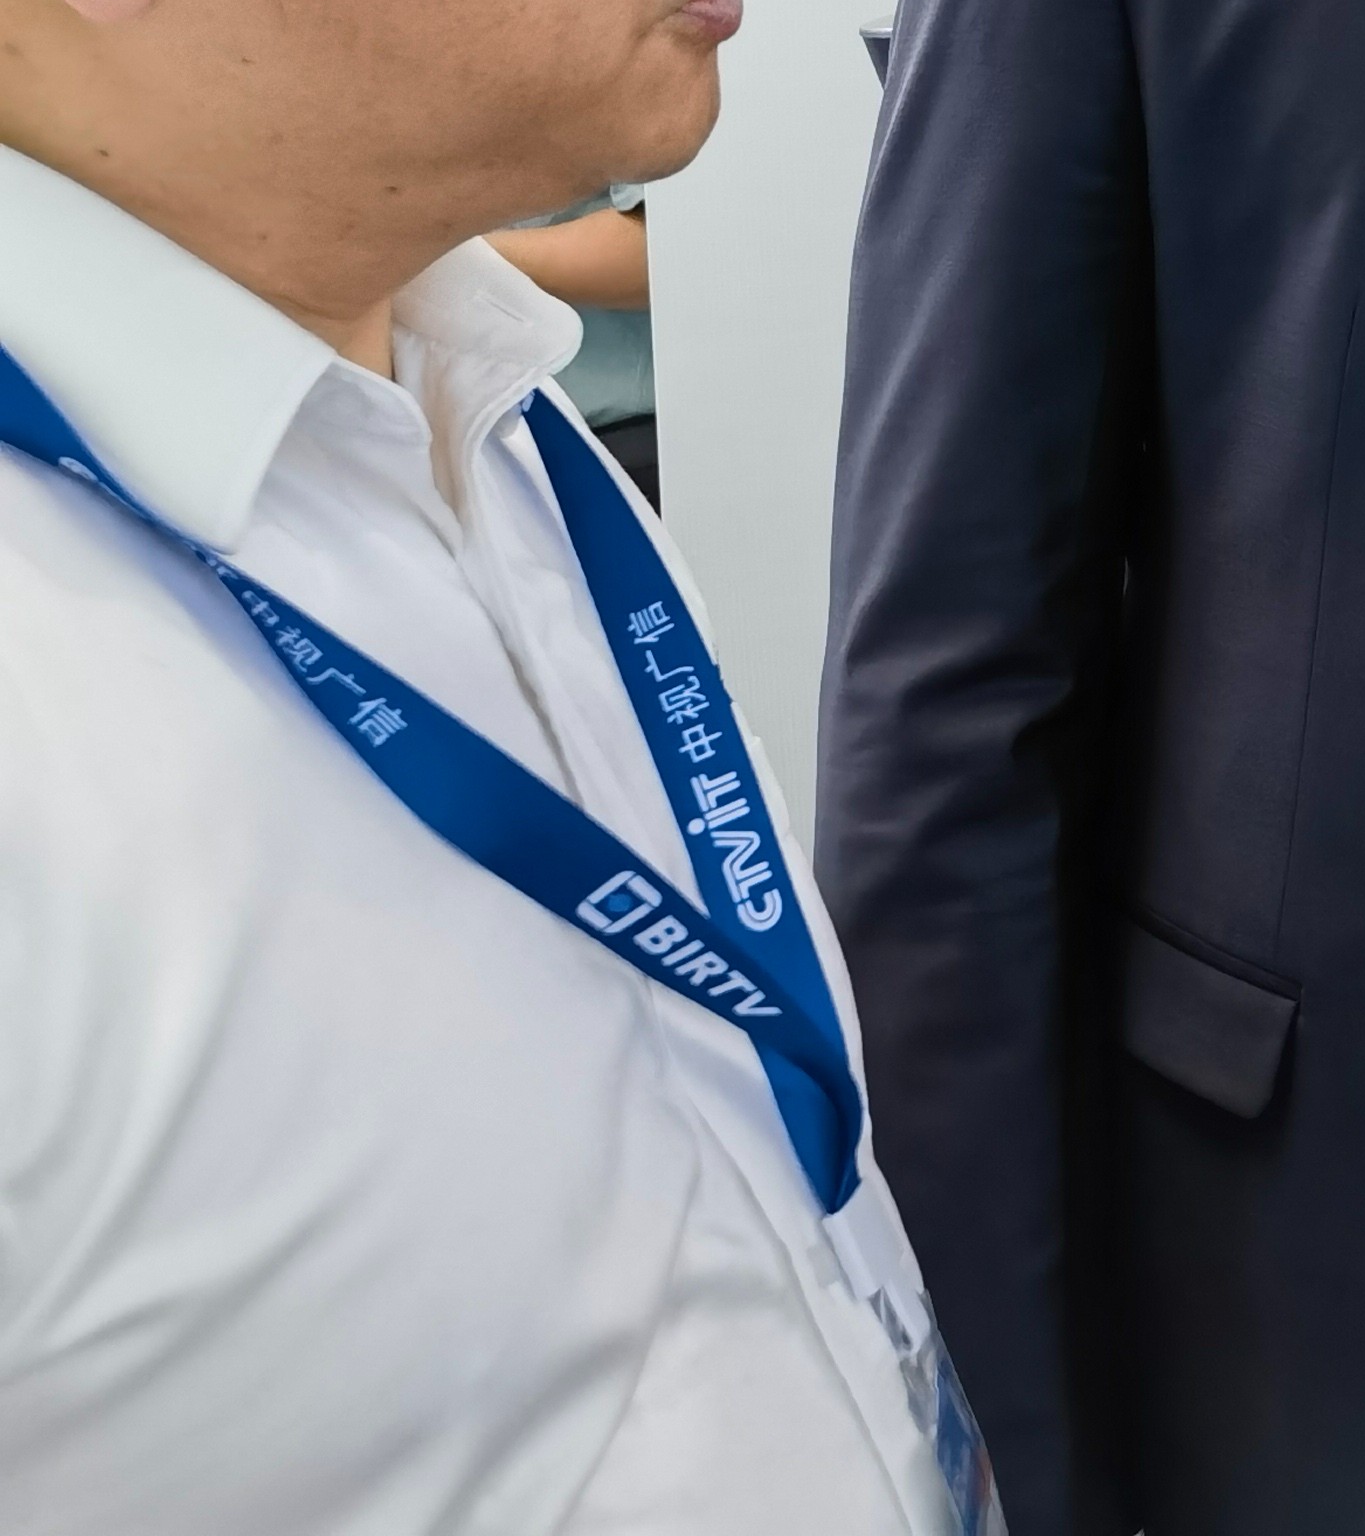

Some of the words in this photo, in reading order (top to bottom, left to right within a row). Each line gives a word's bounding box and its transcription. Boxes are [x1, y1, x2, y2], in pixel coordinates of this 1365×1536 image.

[243, 590, 408, 747] 中视广信
[627, 599, 722, 763] 中视广信
[633, 916, 781, 1017] BIRTV
